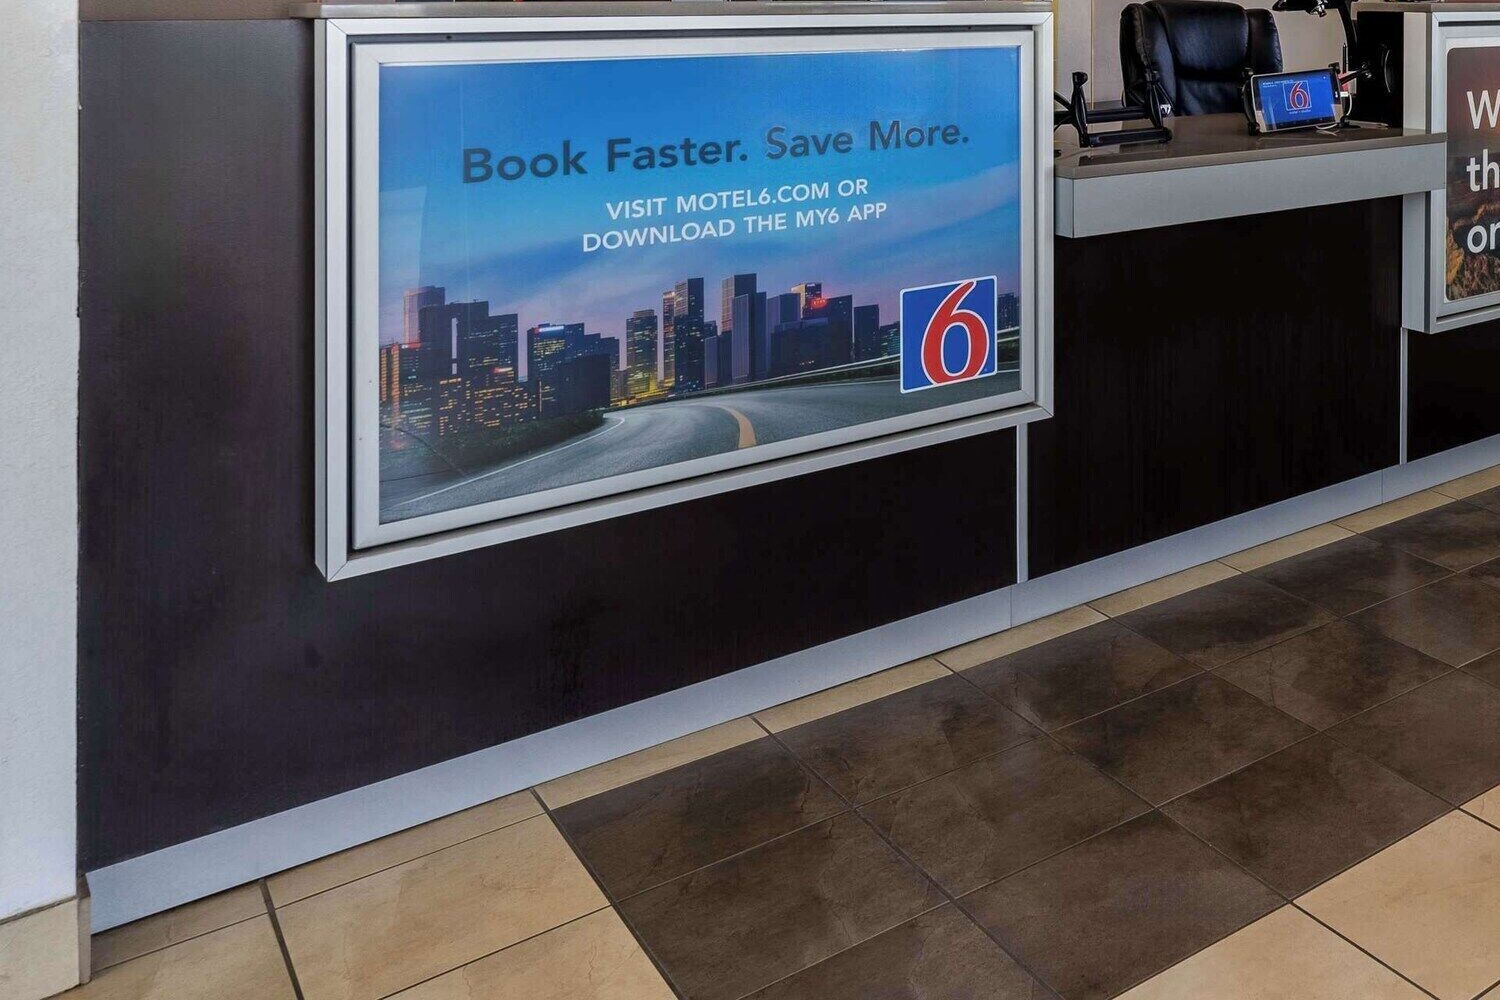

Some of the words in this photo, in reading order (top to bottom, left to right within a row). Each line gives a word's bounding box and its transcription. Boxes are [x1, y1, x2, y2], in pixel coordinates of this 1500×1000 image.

[1289, 80, 1310, 111] 6
[462, 139, 588, 184] Book
[606, 137, 748, 173] Faster.
[765, 126, 854, 161] Save
[869, 120, 970, 152] More.
[606, 197, 668, 221] VISIT
[676, 182, 829, 214] MOTEL6.COM
[837, 178, 868, 198] OR
[582, 218, 736, 253] DOWNLOAD
[743, 212, 787, 234] THE
[796, 207, 840, 228] MY6
[847, 202, 887, 222] APP
[921, 279, 990, 386] 6
